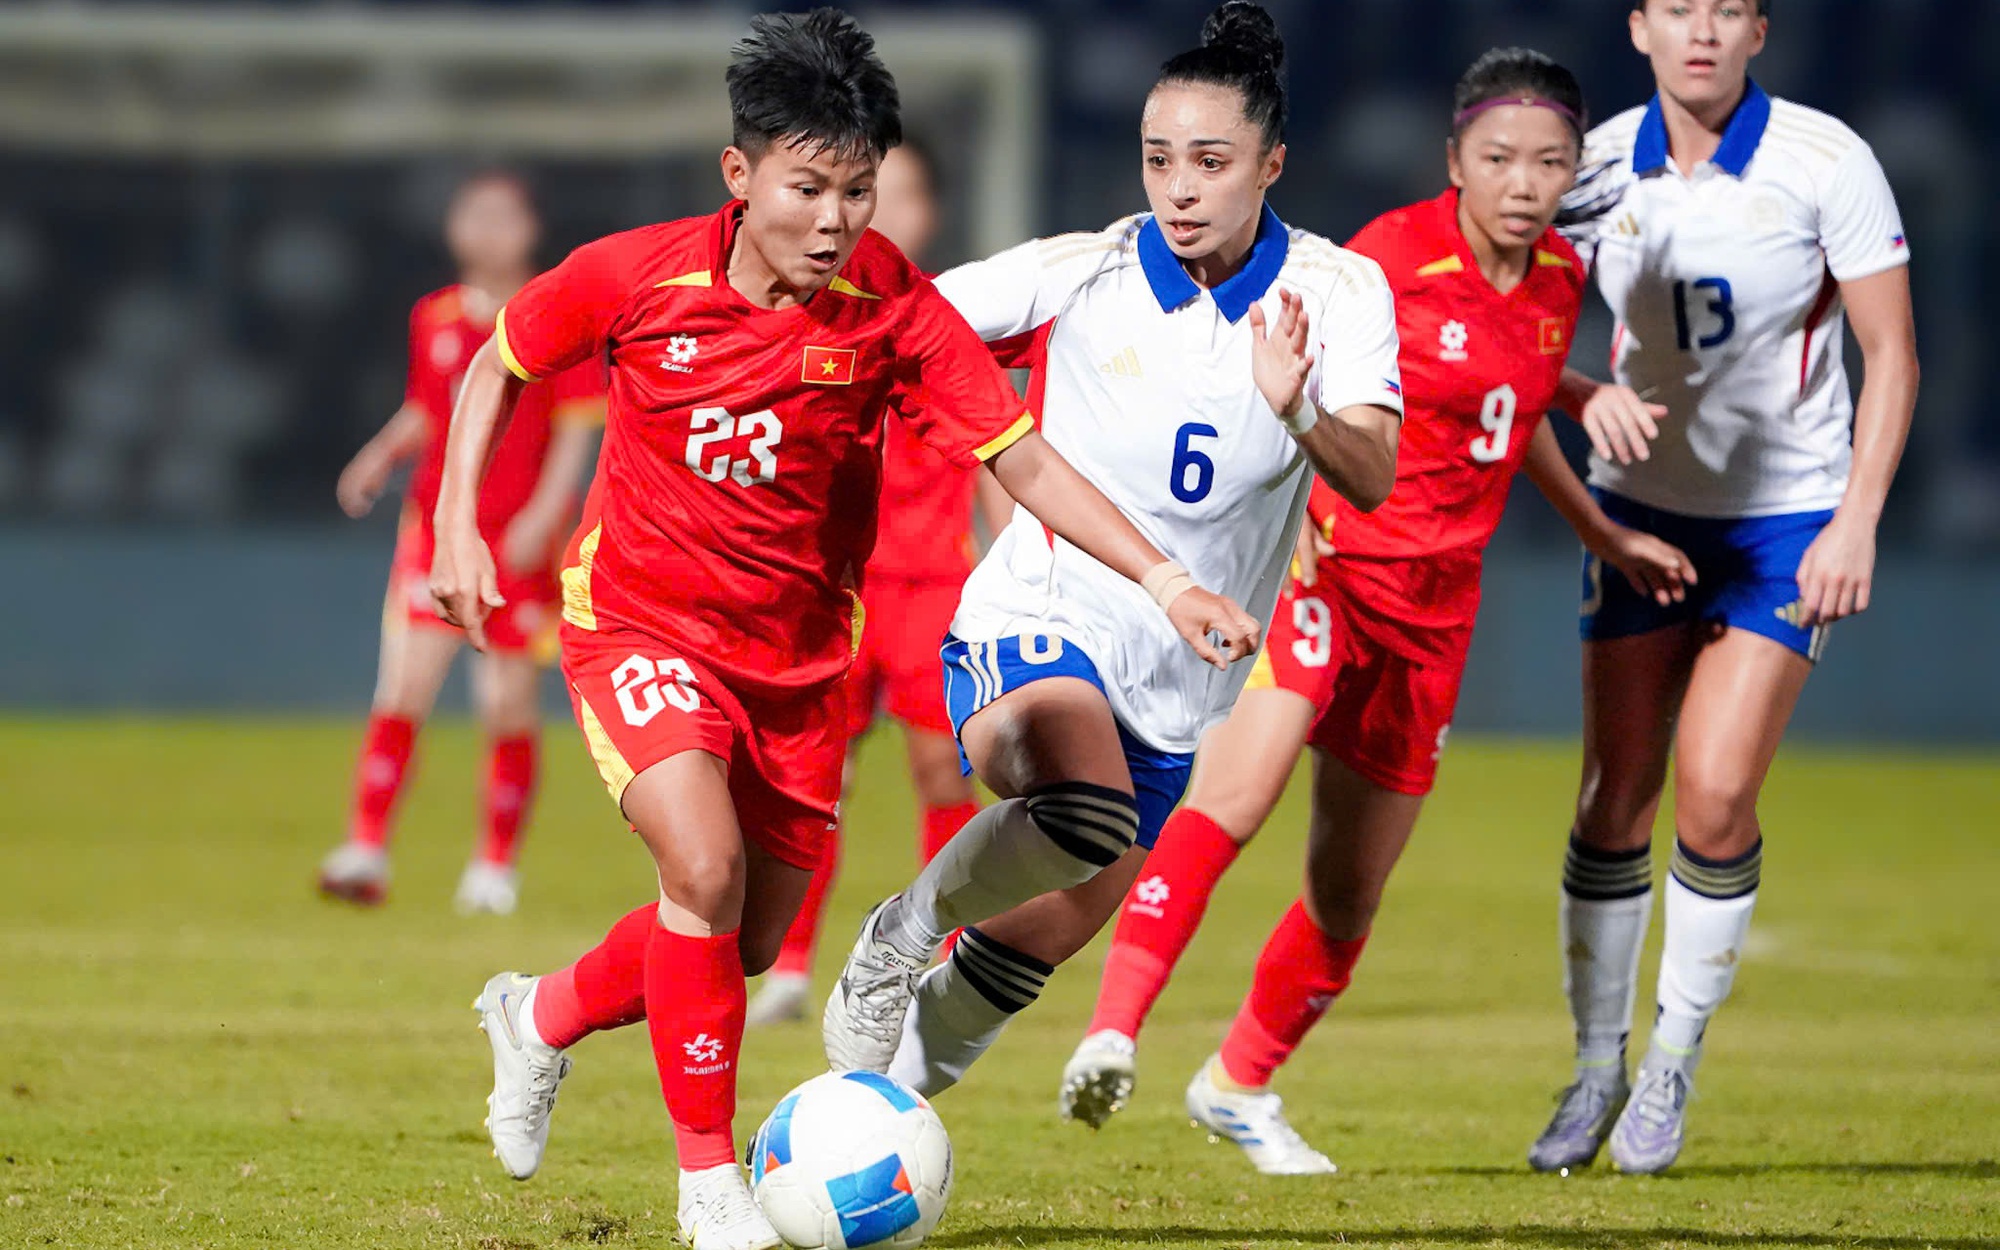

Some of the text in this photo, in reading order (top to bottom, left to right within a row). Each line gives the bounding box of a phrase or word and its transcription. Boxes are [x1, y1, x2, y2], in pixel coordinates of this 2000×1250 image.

[1672, 277, 1735, 352] 13
[686, 406, 784, 488] 23
[1470, 384, 1517, 462] 9
[1170, 422, 1219, 504] 6
[1292, 597, 1332, 668] 9
[610, 653, 701, 728] 23
